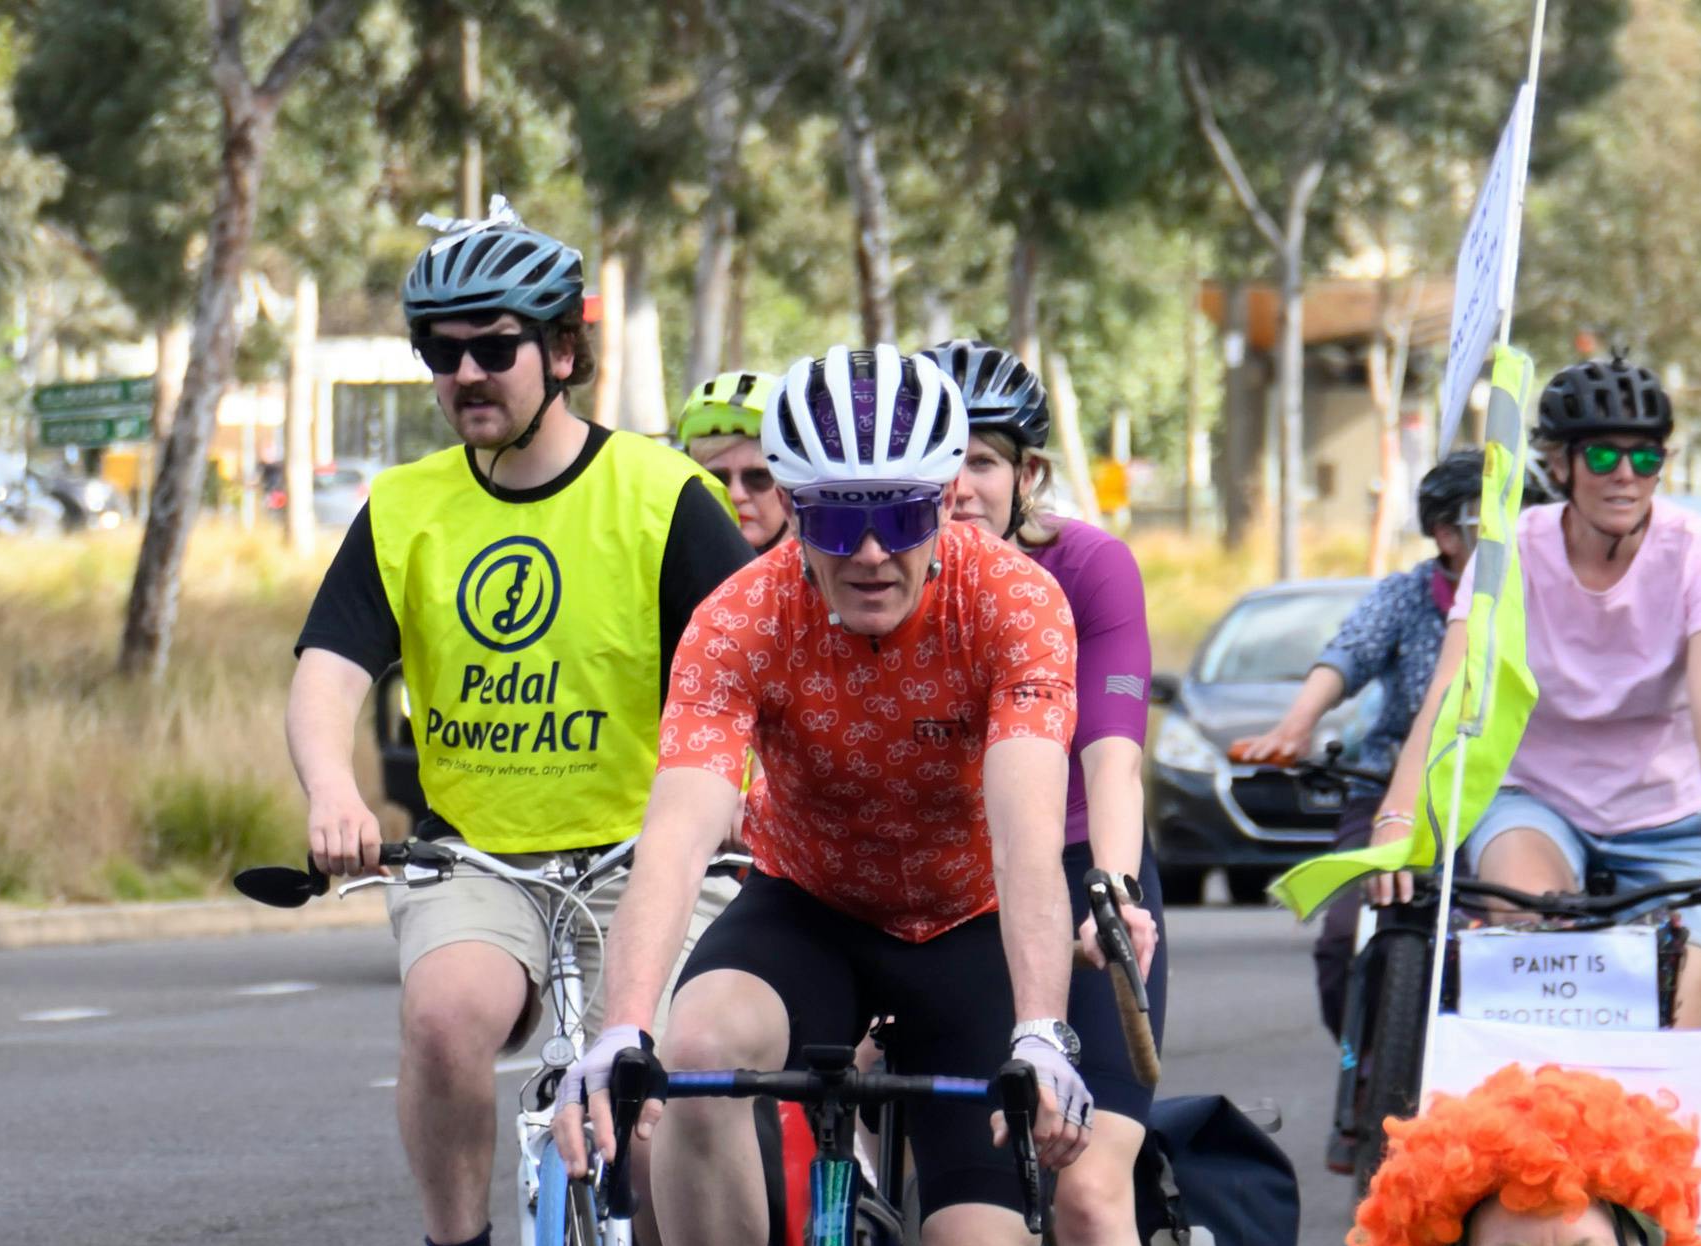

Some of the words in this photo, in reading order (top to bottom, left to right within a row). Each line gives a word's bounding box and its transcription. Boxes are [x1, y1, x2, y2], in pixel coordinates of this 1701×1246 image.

[459, 660, 561, 705] Pedal
[425, 707, 530, 753] Power
[531, 709, 609, 753] ACT
[474, 763, 496, 777] any
[541, 764, 566, 779] any
[568, 762, 599, 776] time
[1512, 954, 1579, 974] PAINT
[1587, 954, 1606, 974] IS
[1542, 981, 1578, 999] NO
[1483, 1008, 1629, 1026] PROTECTION
